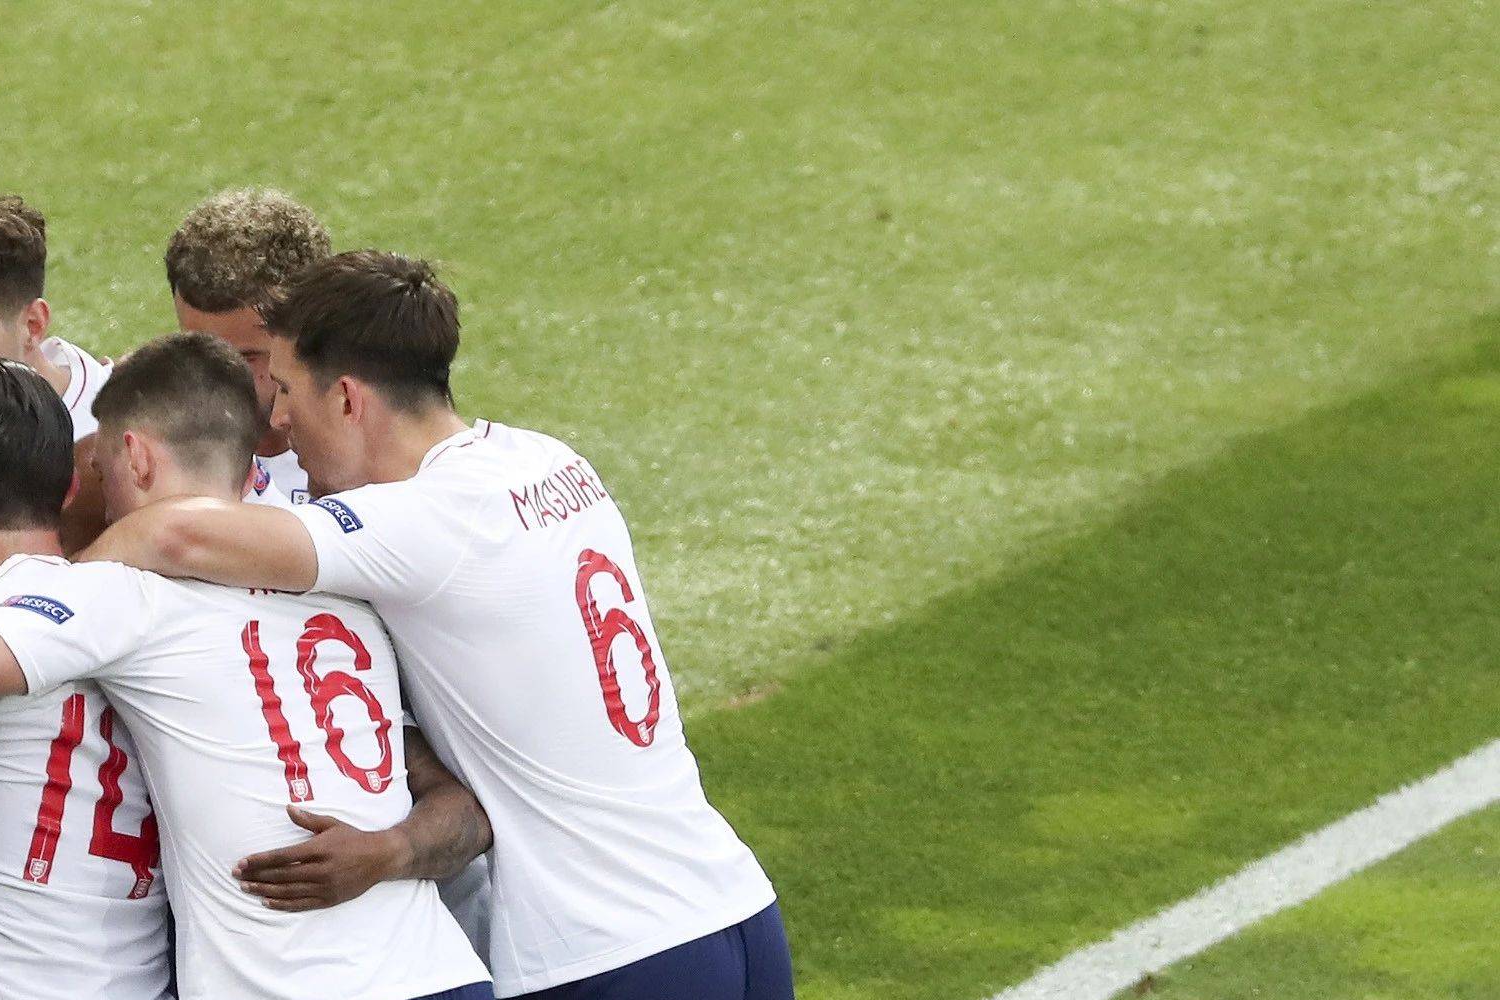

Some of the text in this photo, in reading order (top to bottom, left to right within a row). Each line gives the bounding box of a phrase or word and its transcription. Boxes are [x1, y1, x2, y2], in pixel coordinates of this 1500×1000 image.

[508, 460, 606, 531] MAGUIRE
[17, 597, 70, 621] RESPECT
[575, 548, 661, 748] 6
[22, 693, 161, 900] 14
[241, 613, 393, 804] 16
